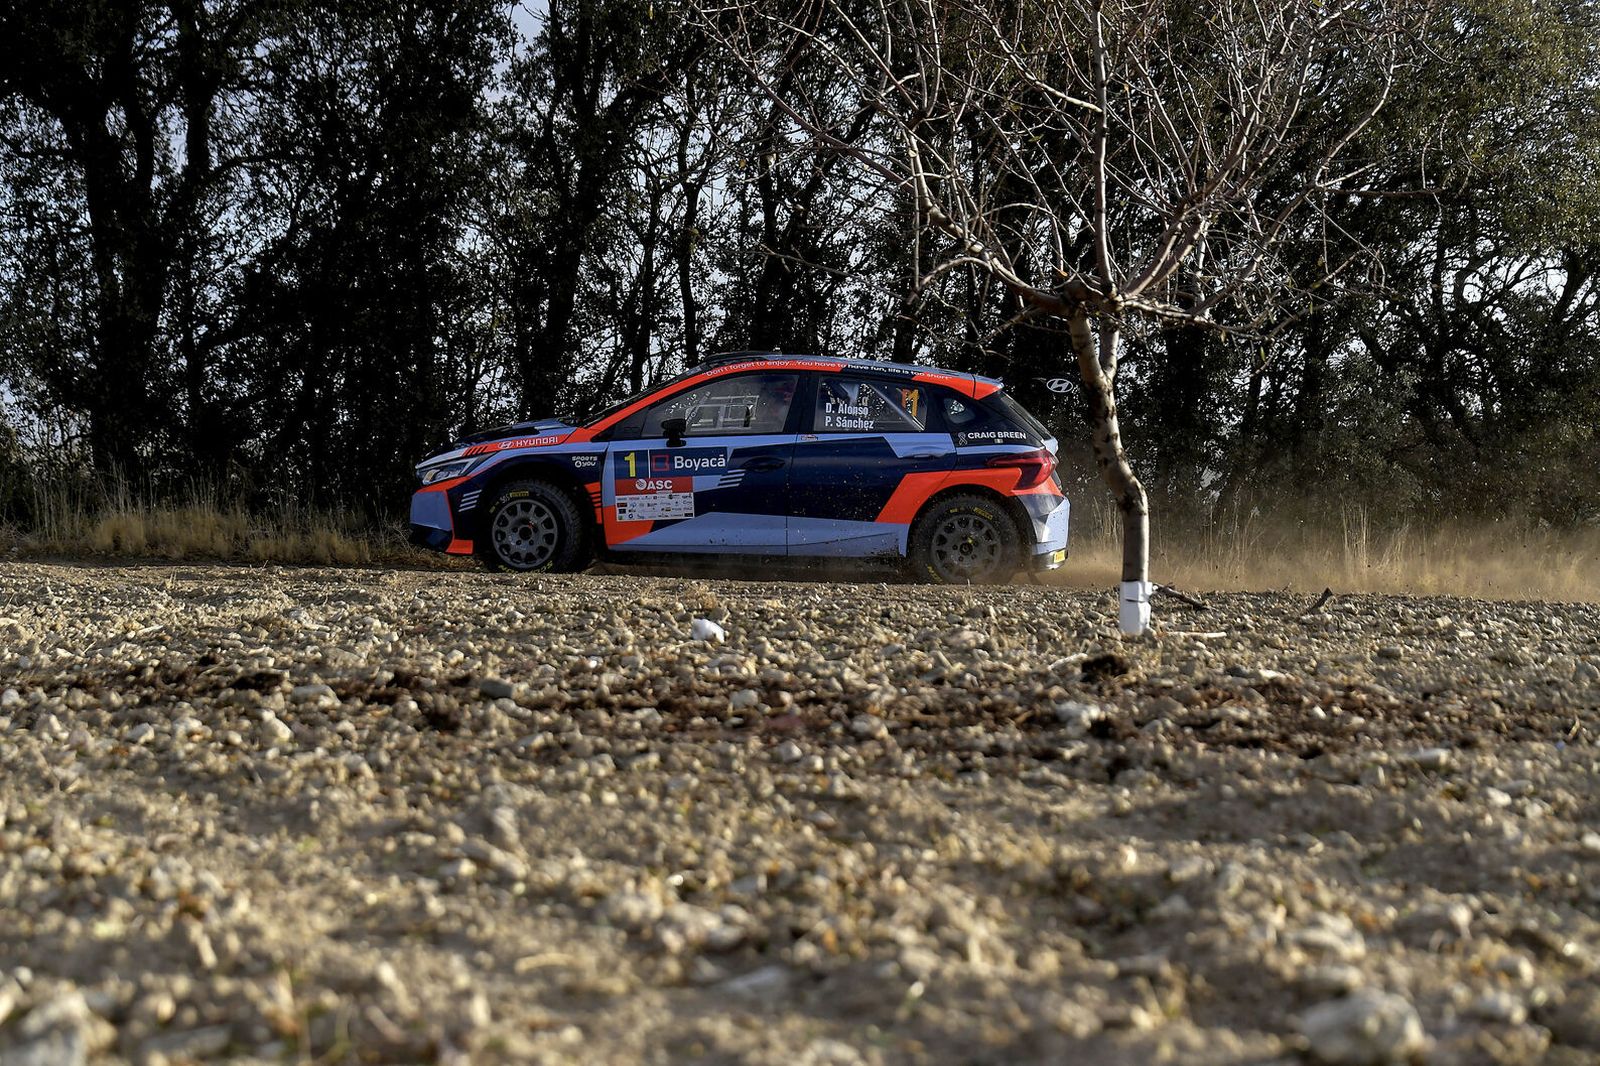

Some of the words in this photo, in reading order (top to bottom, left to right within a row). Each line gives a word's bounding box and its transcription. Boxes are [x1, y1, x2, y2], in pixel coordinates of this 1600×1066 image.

[730, 361, 755, 369] forget
[826, 402, 835, 414] D.
[838, 403, 869, 416] Alonso
[825, 415, 833, 427] P.
[836, 416, 874, 429] Sánchez
[516, 436, 558, 446] HYUNDAI
[998, 432, 1026, 440] BREEN
[624, 452, 636, 478] 1
[646, 480, 673, 490] ASC
